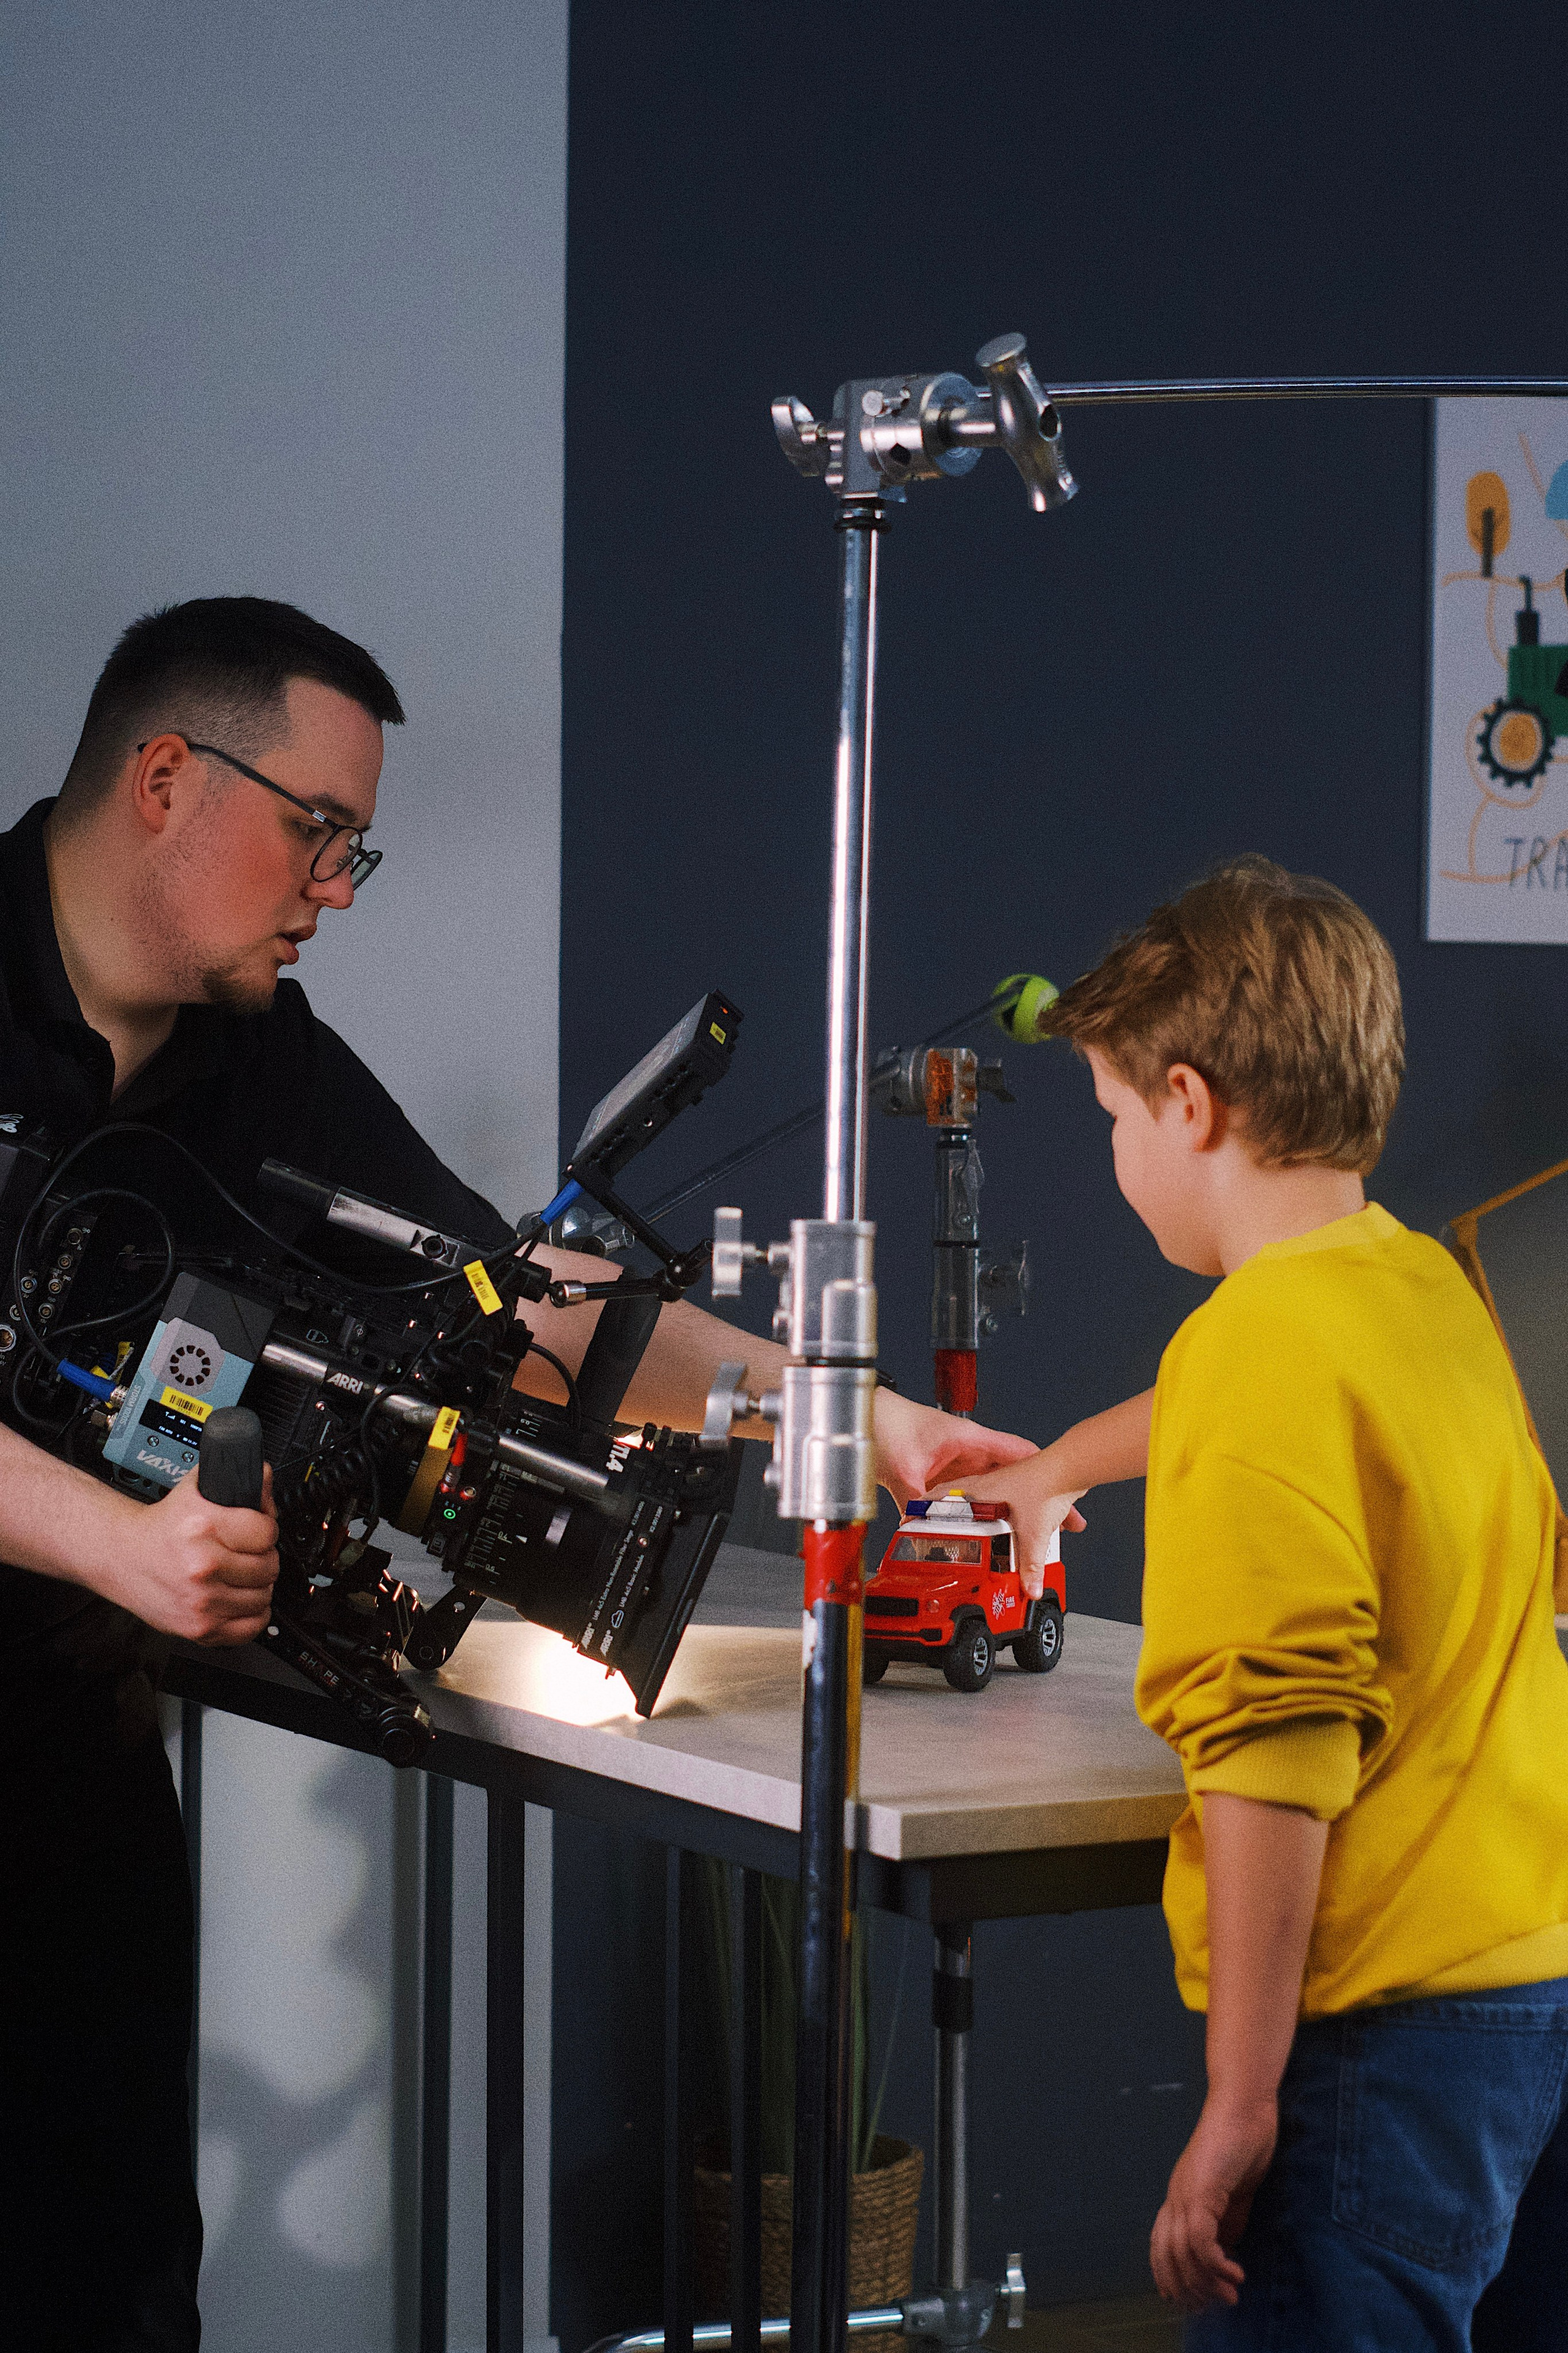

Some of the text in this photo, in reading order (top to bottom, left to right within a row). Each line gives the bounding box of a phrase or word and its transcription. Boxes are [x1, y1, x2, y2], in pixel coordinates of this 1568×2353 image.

[326, 1372, 363, 1395] ARRI
[127, 1384, 141, 1407] STORM
[633, 1554, 644, 1573] Module
